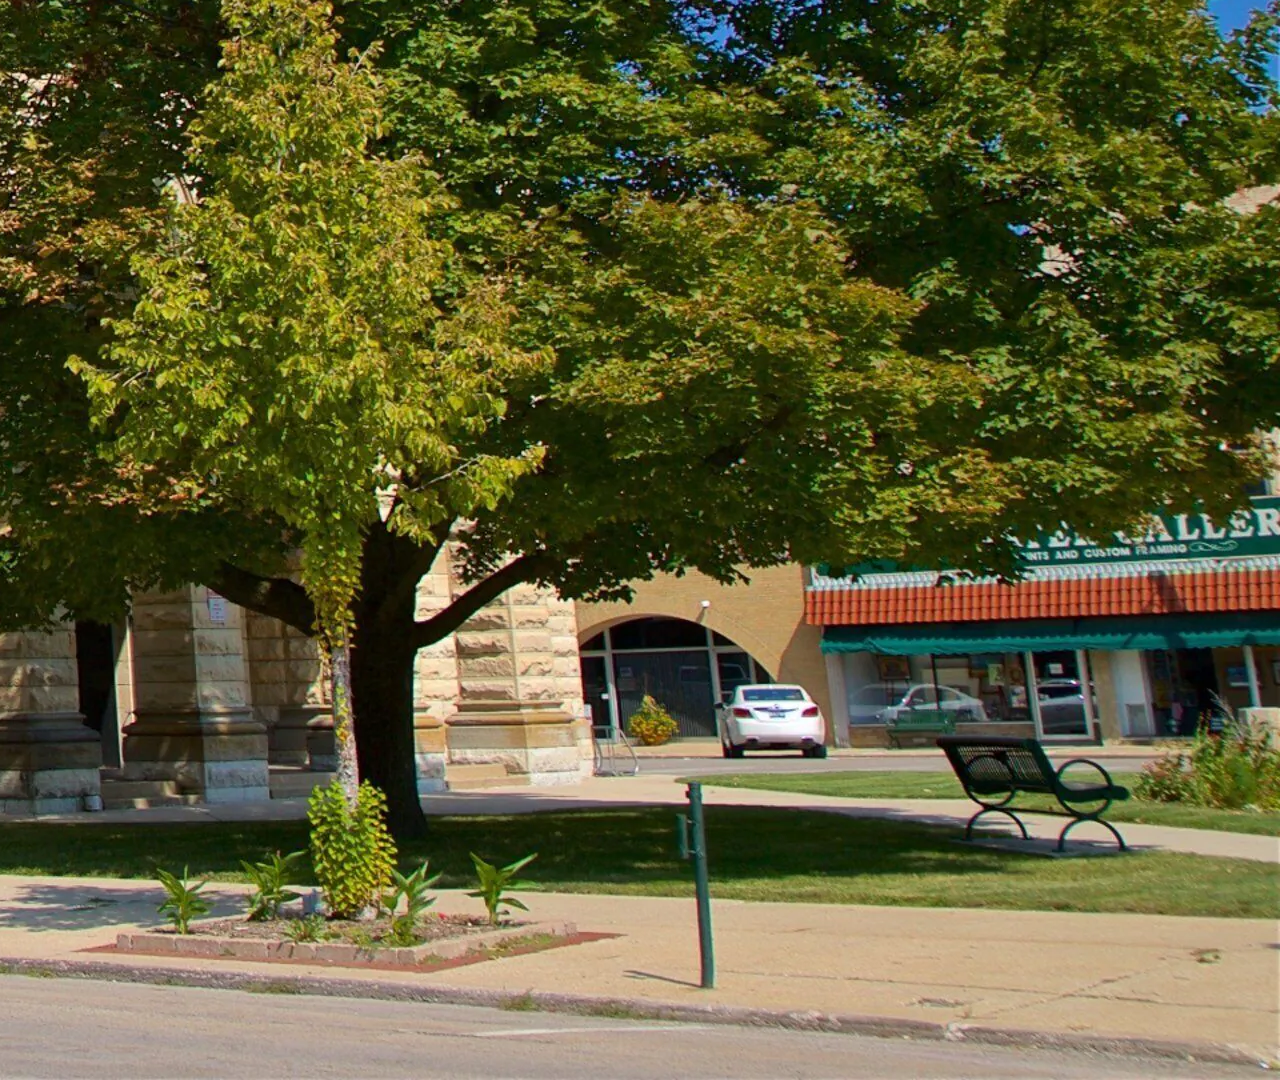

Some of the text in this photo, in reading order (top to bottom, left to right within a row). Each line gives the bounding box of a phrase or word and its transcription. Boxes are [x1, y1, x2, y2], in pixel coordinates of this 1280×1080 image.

[1055, 549, 1079, 560] AND
[1084, 546, 1130, 558] CUSTOM
[1135, 544, 1187, 556] FRAMING
